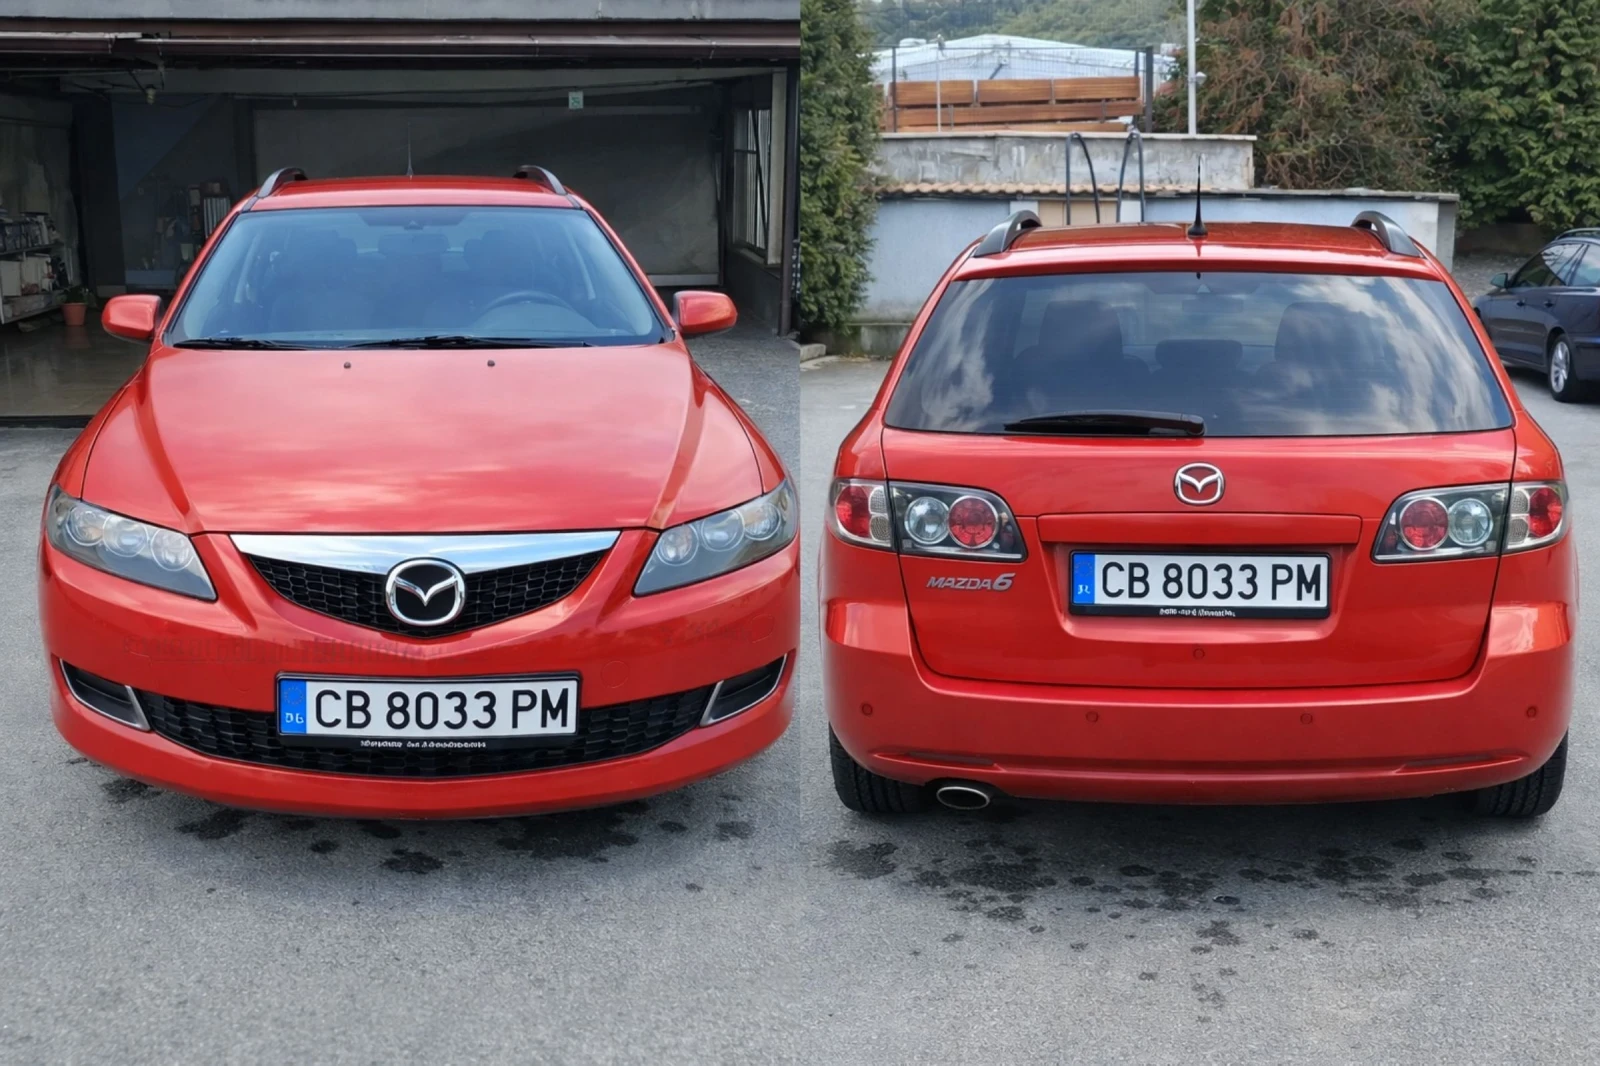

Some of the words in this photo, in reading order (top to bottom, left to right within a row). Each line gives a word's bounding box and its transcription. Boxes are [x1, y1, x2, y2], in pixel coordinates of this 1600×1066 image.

[1102, 562, 1150, 598] CB
[1162, 563, 1258, 600] 8033
[1271, 564, 1321, 601] PM
[315, 690, 372, 729] CB
[386, 691, 497, 730] 8033
[511, 688, 569, 729] PM
